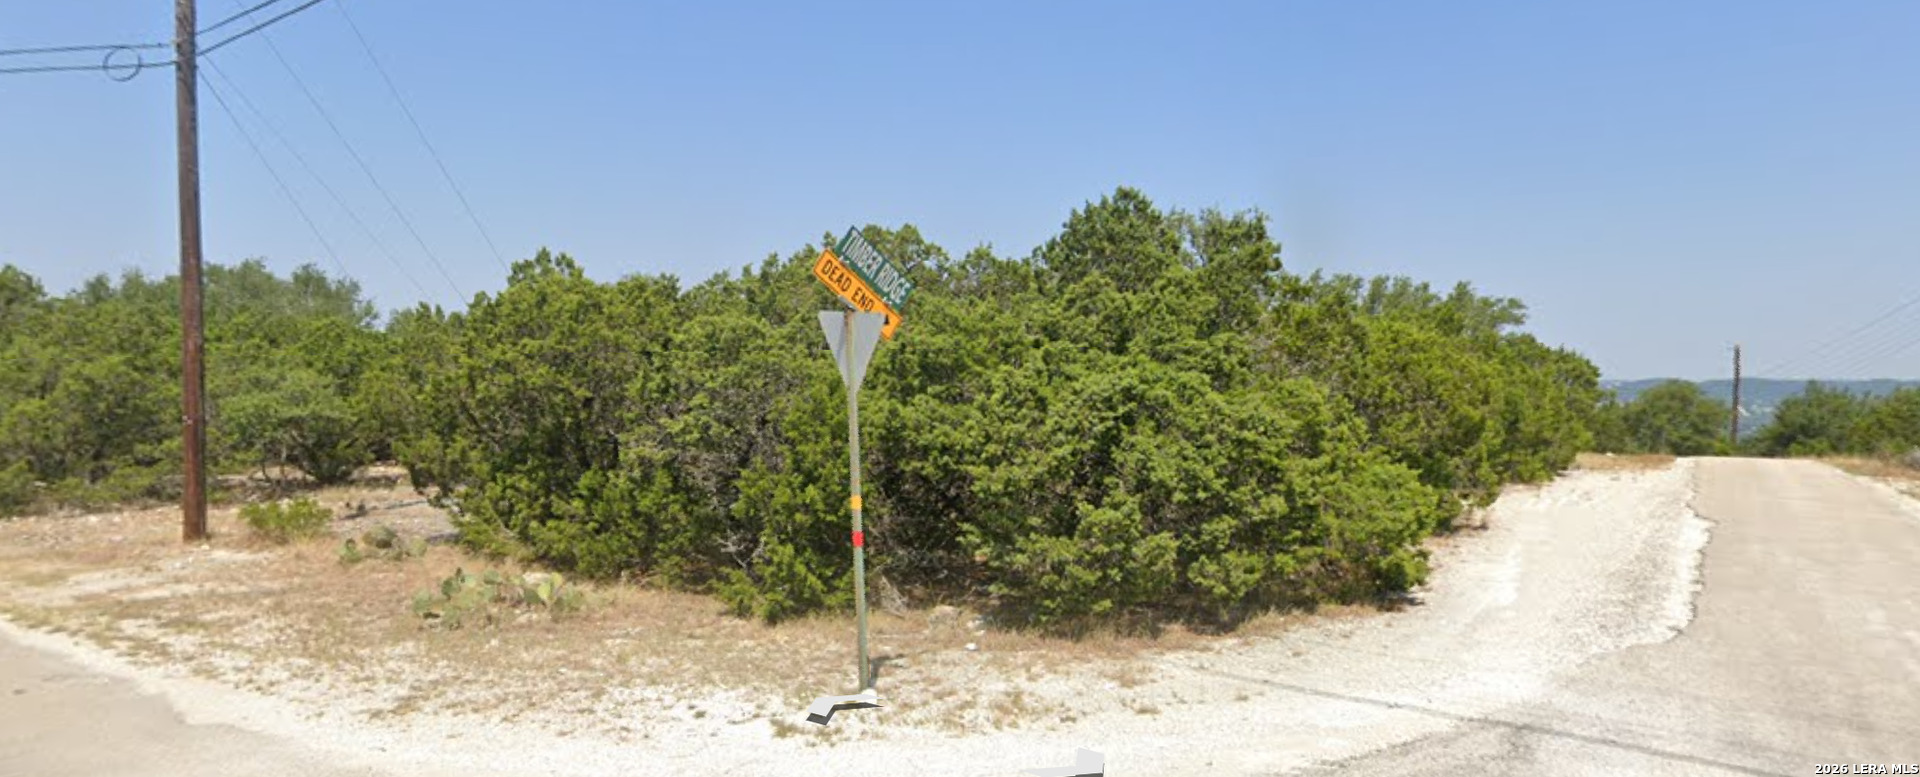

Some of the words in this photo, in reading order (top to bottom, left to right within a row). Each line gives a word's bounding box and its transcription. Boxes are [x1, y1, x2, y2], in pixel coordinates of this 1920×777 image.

[821, 260, 852, 292] DEAD
[851, 287, 875, 312] END
[842, 229, 884, 280] TIMBER
[874, 263, 912, 304] RIDGE
